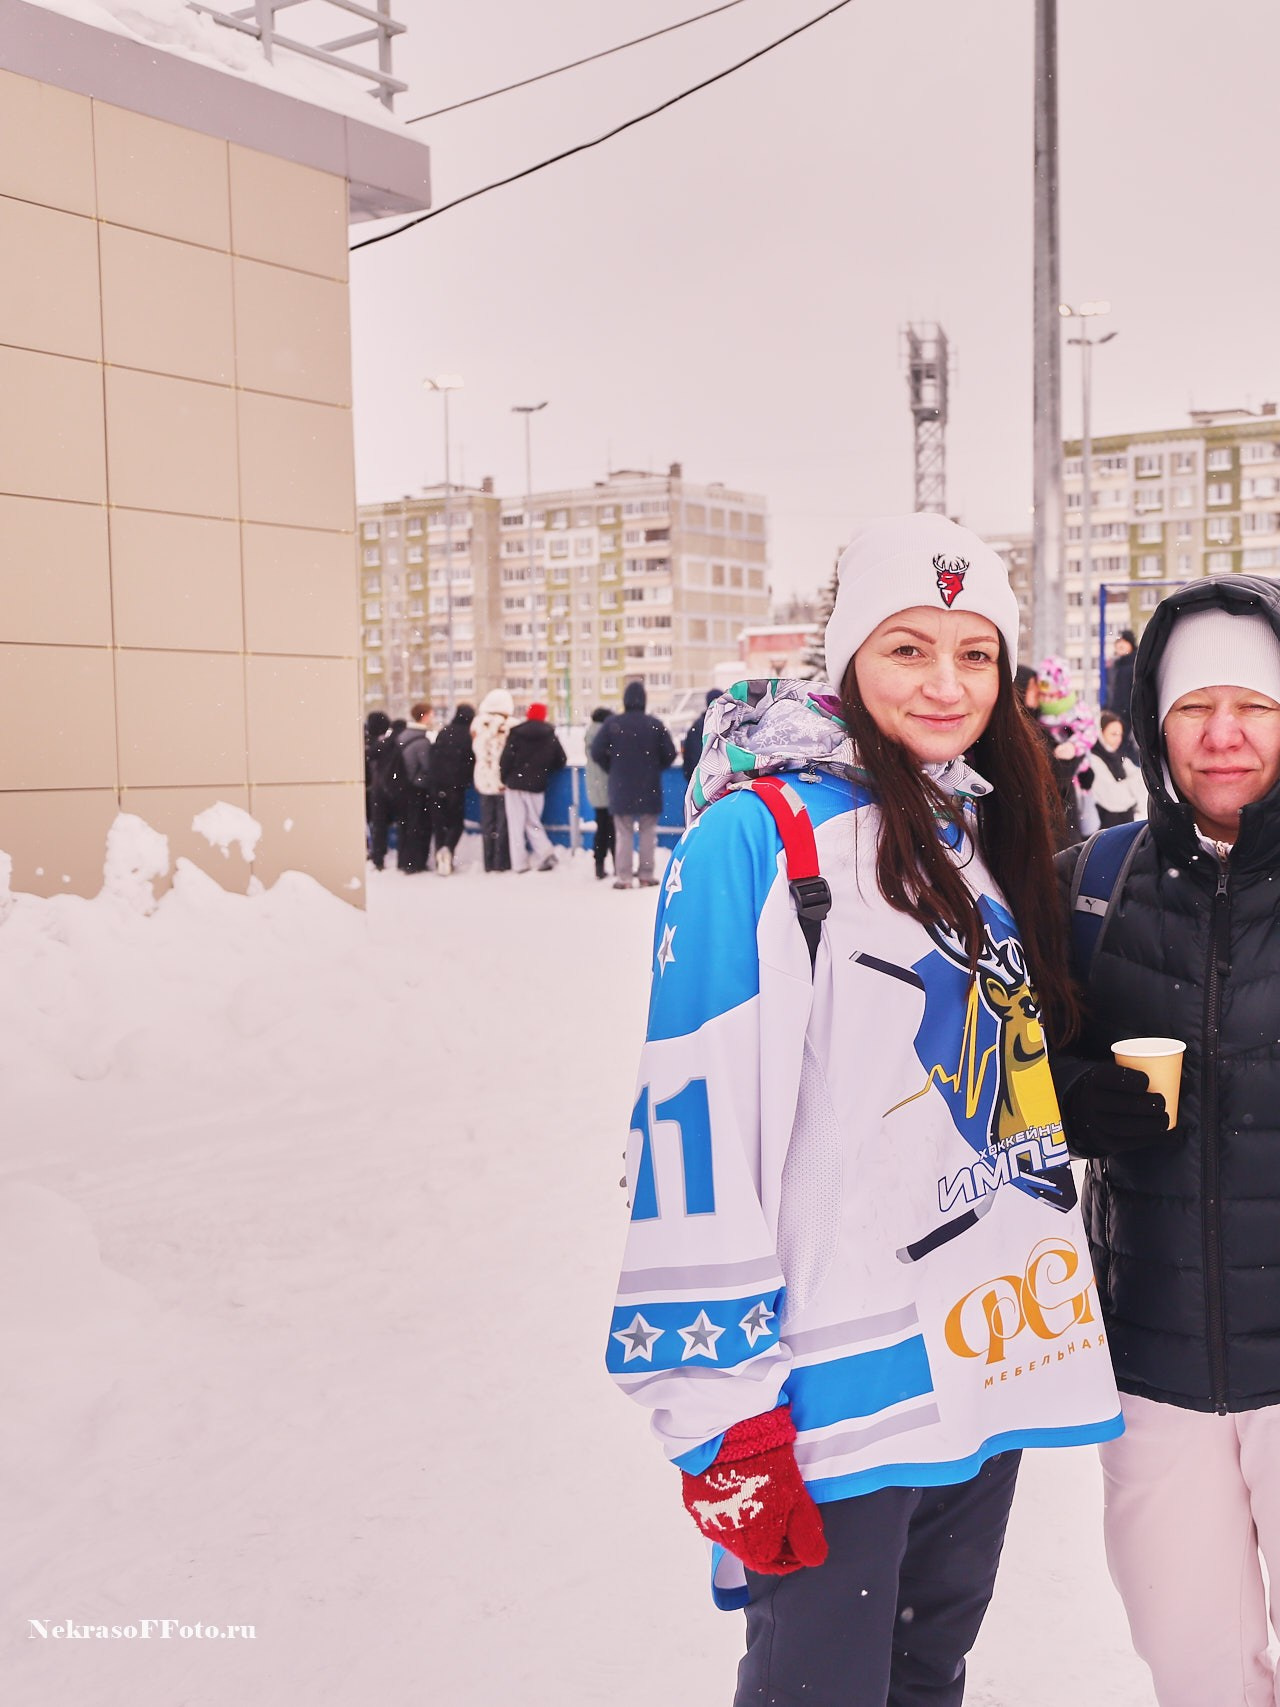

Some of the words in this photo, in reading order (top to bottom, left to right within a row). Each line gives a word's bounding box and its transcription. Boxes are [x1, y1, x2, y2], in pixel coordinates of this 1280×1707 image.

[629, 1075, 717, 1224] 11
[937, 1133, 1070, 1213] ИМПУ
[979, 1120, 1064, 1161] ХОККЕЙНЫ
[984, 1333, 1105, 1390] МЕБЕЛЬНАЯ
